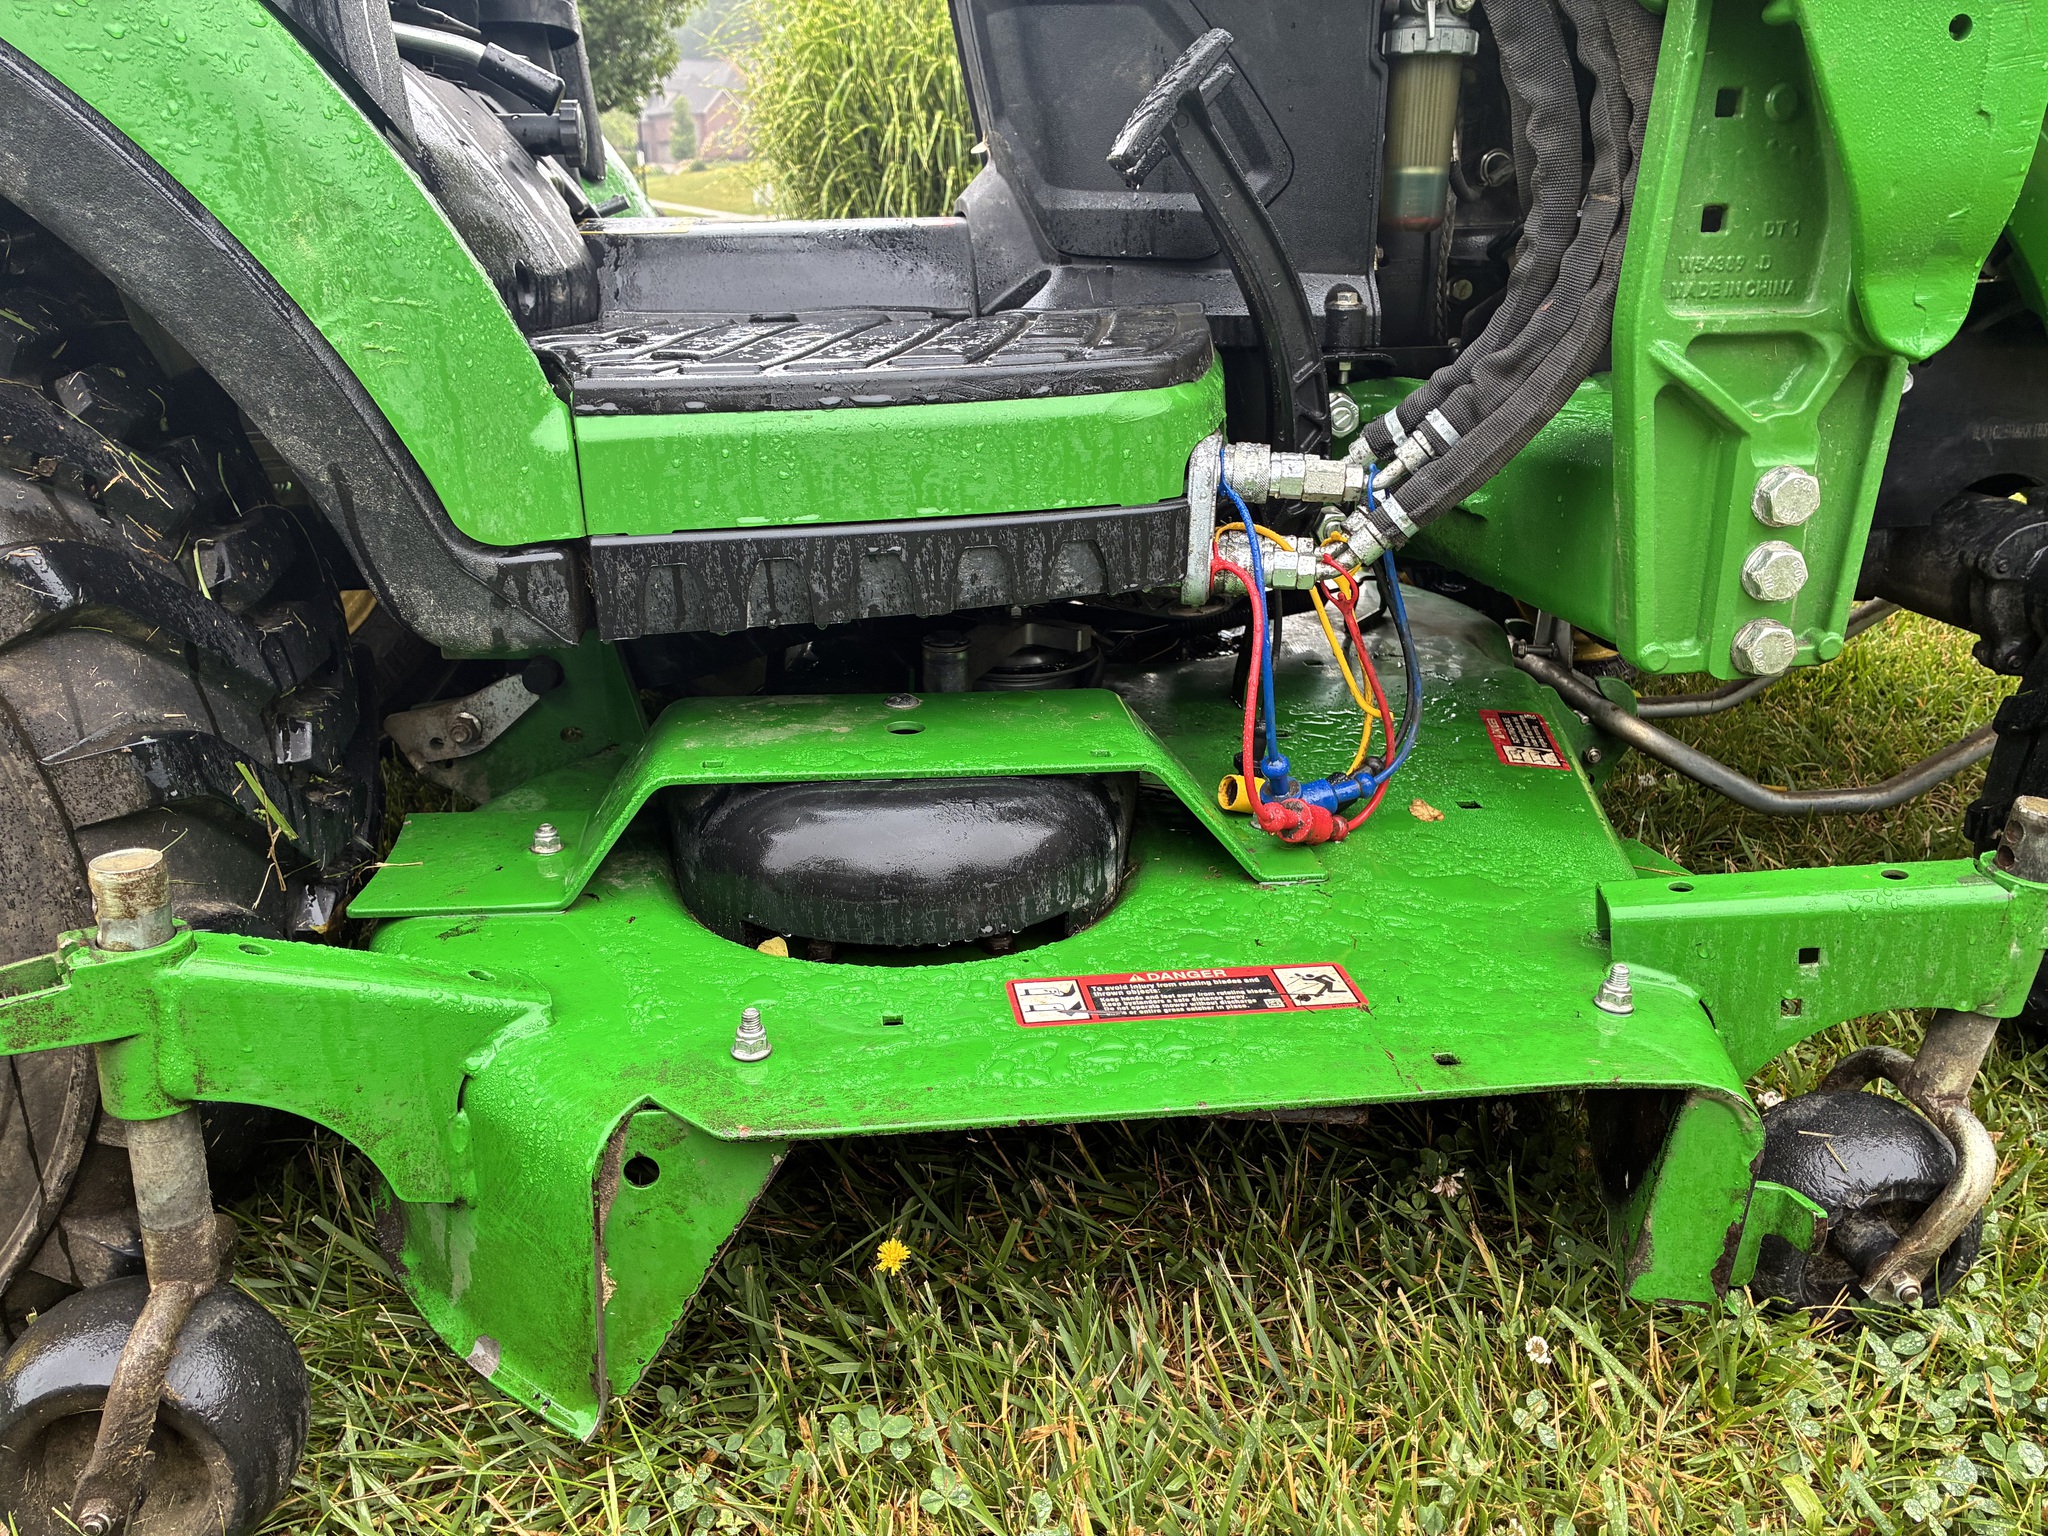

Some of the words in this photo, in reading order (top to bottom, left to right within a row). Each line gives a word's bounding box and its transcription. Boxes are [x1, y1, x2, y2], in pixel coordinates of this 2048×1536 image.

[1670, 280, 1721, 299] MADE
[1724, 280, 1742, 298] IN
[1744, 278, 1795, 298] CHINA
[1146, 969, 1227, 981] DANGER
[1213, 977, 1242, 985] blades
[1126, 988, 1161, 996] objects:
